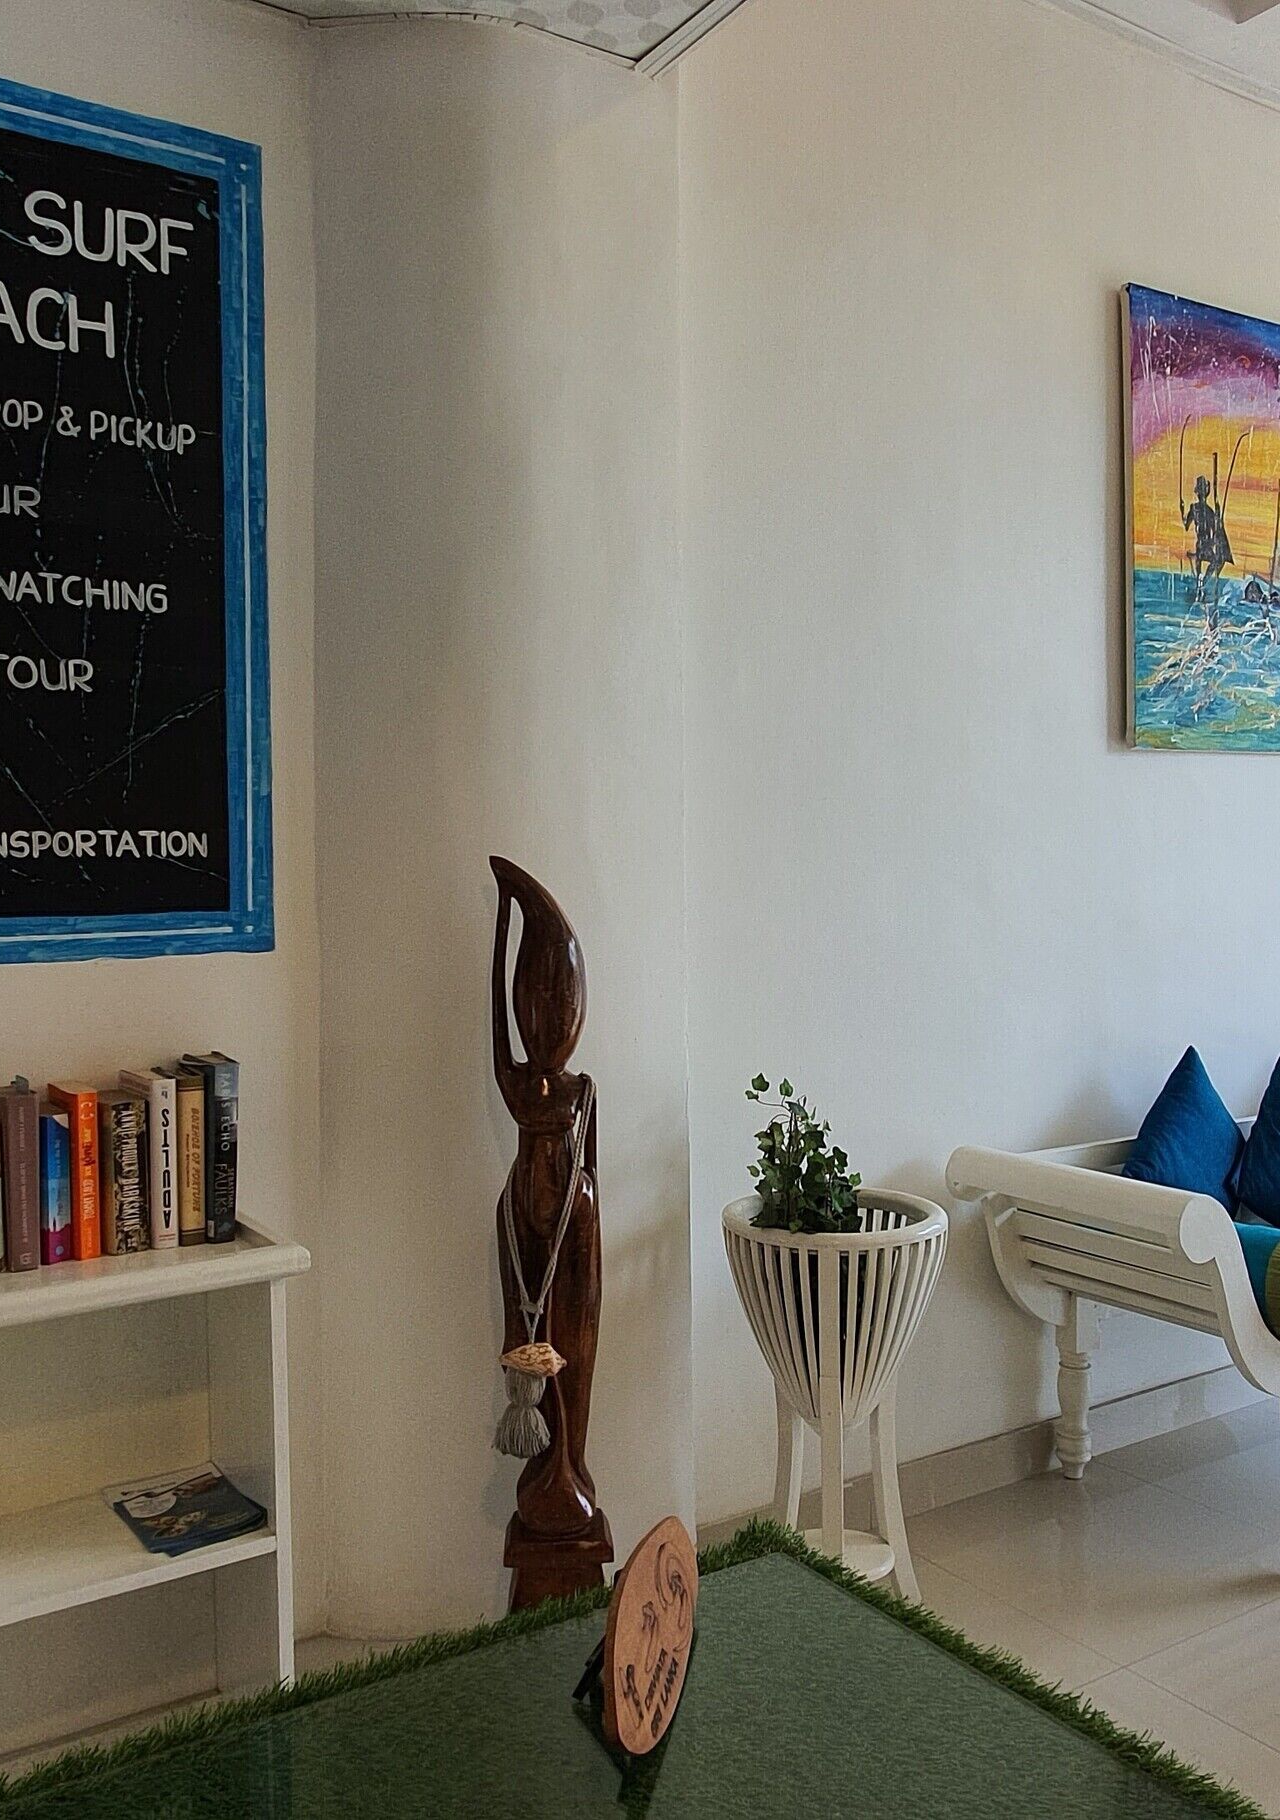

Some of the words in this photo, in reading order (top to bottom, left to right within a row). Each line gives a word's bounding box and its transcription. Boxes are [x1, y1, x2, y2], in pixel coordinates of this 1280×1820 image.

[25, 191, 193, 274] SURF
[57, 406, 81, 437] &
[91, 411, 195, 454] PICKUP
[217, 1073, 231, 1108] PARIS
[120, 1110, 136, 1138] ANNIE
[220, 1116, 231, 1151] ECHO
[121, 1139, 137, 1173] PROULX
[161, 1109, 172, 1229] ADULTS
[123, 1178, 141, 1232] BARKSKINS
[192, 1167, 201, 1212] FORTUNE
[214, 1163, 228, 1215] FAULKS
